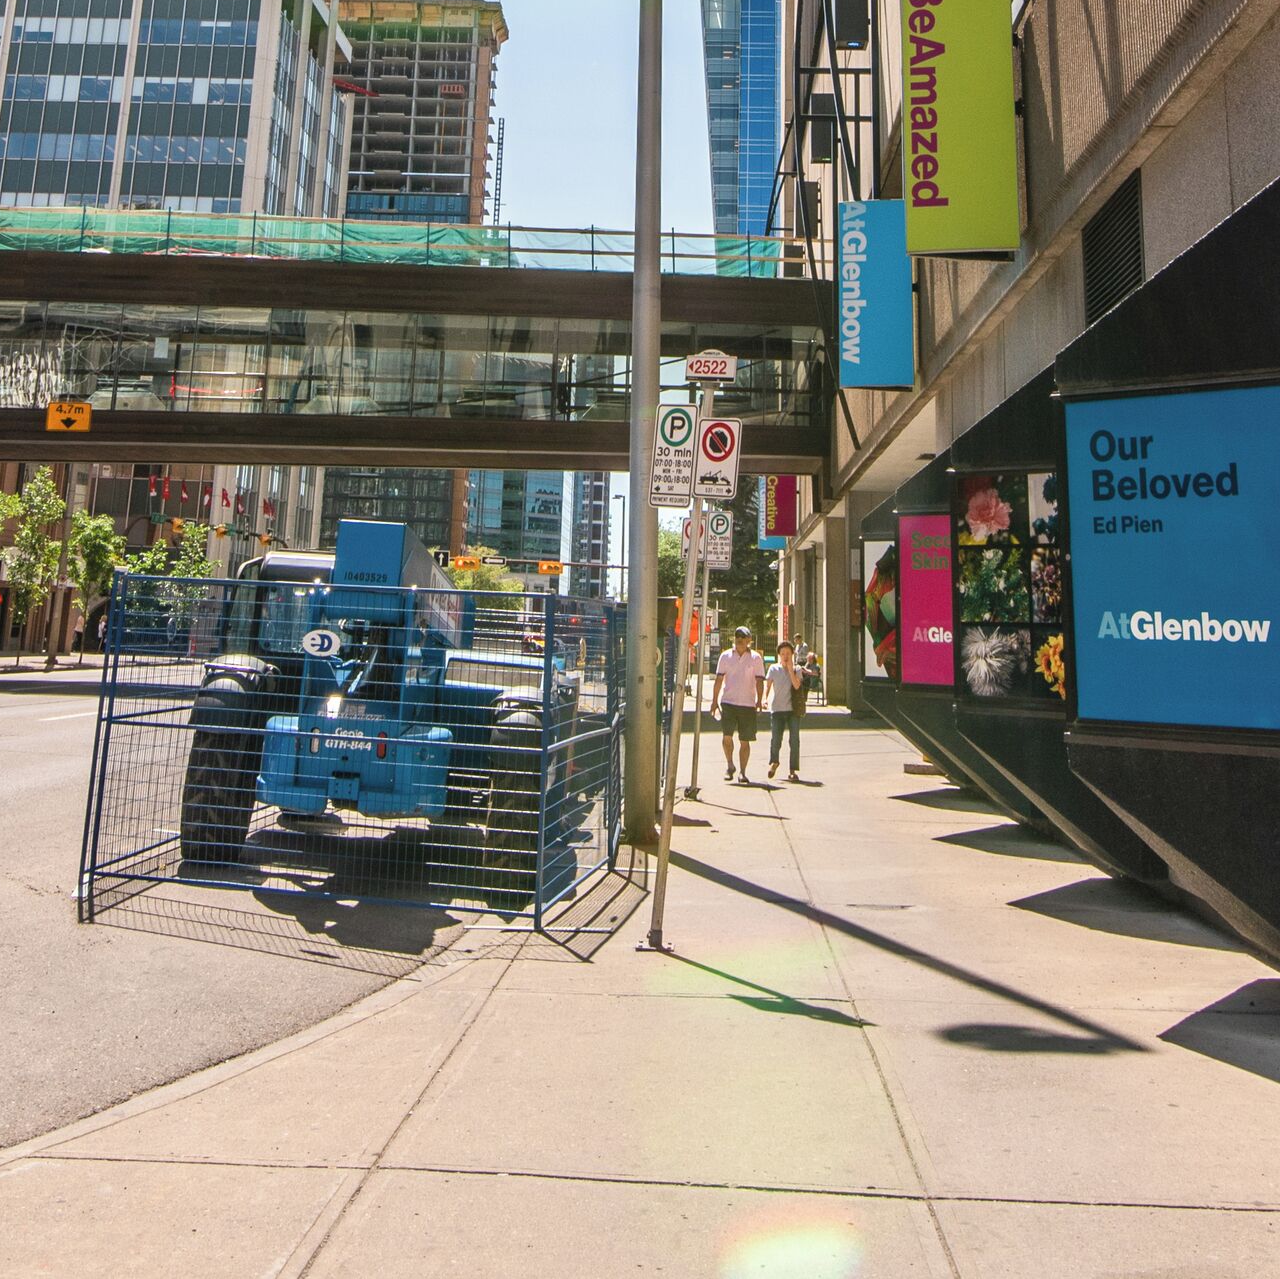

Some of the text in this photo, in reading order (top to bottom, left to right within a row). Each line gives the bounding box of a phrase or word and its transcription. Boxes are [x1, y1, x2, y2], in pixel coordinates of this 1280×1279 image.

[840, 201, 868, 364] AtGlenbow
[694, 360, 727, 375] 2522
[56, 404, 84, 414] 4.7m
[669, 415, 686, 439] P
[657, 447, 692, 458] 30 min
[1089, 430, 1154, 462] Our
[1092, 464, 1239, 501] Beloved
[767, 475, 778, 530] Creative
[1093, 516, 1163, 535] Ed Pien
[911, 552, 949, 570] Skin
[1098, 611, 1271, 644] AtGlenbow
